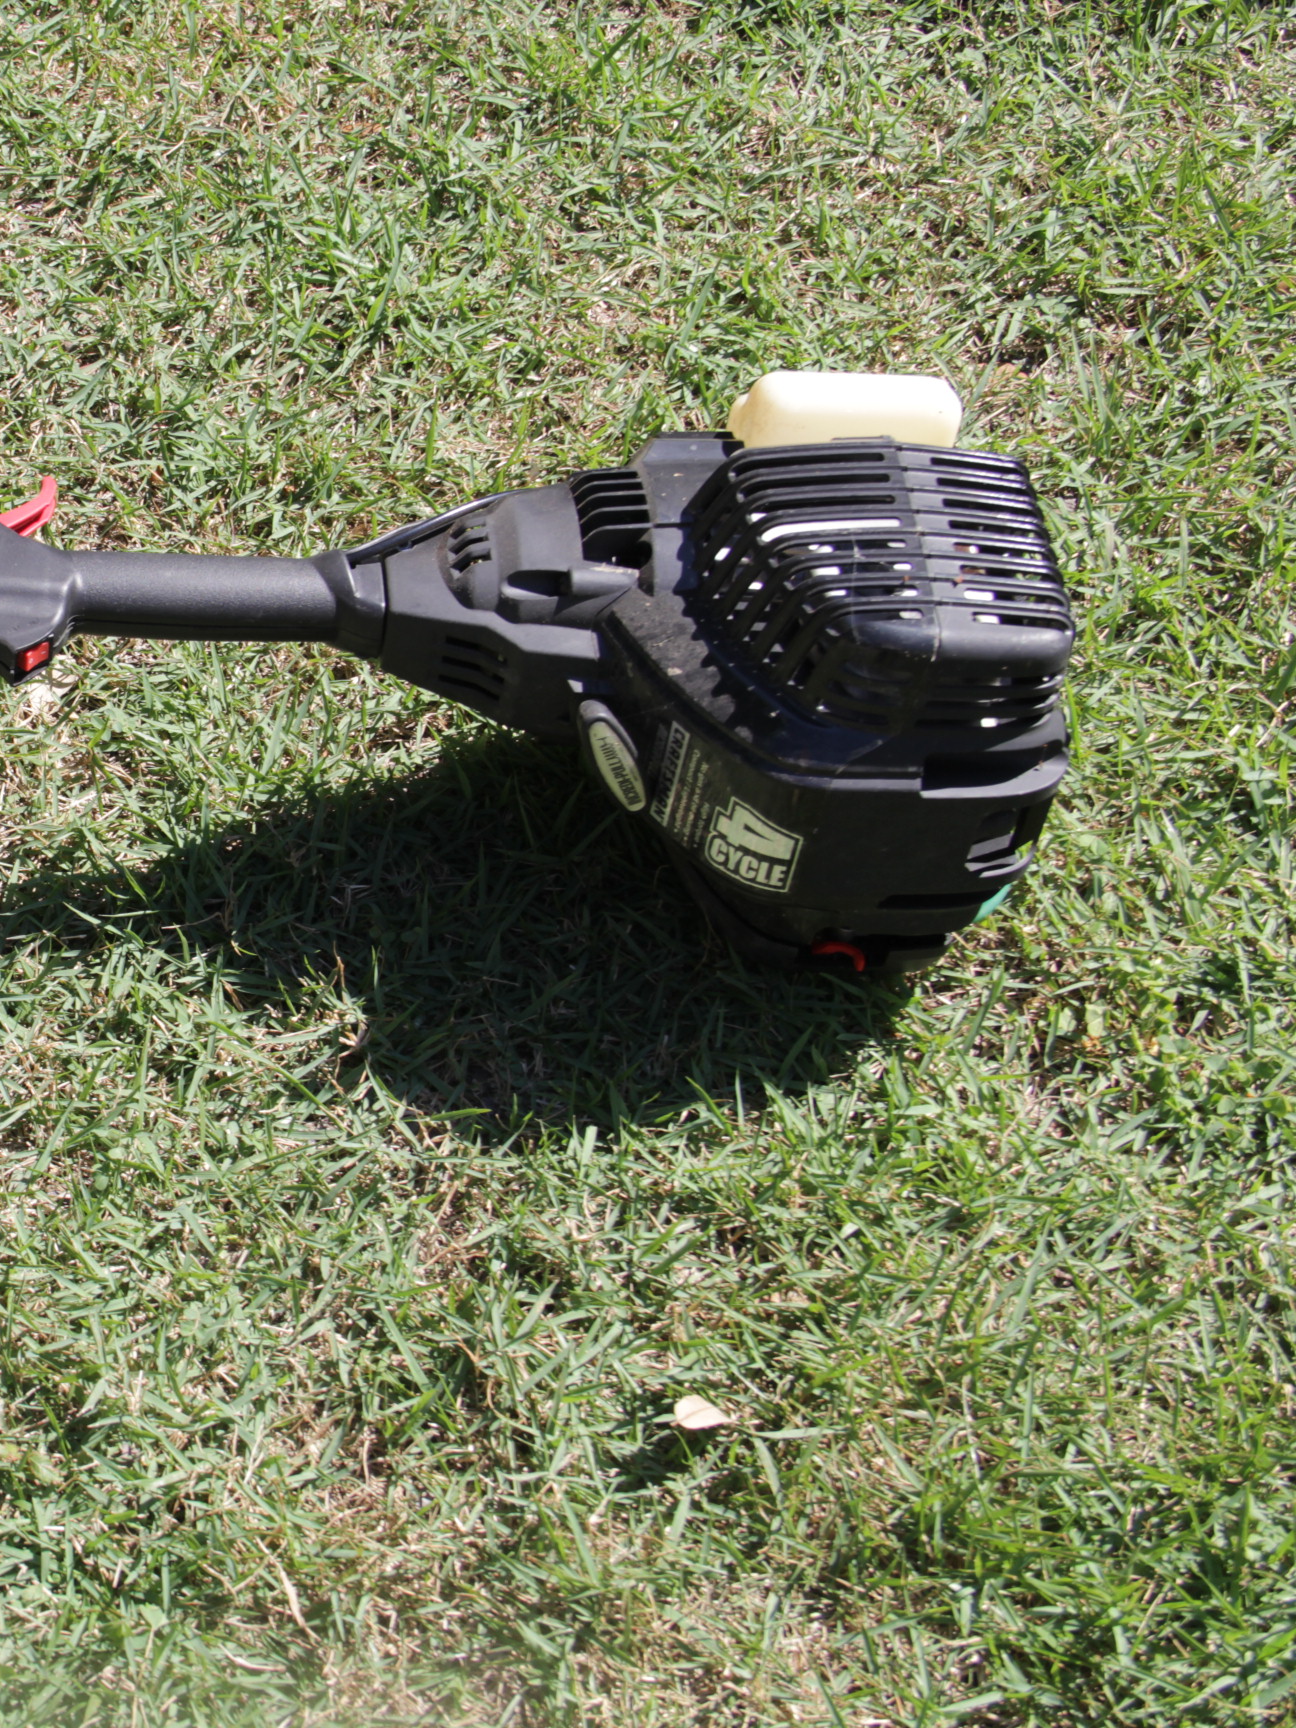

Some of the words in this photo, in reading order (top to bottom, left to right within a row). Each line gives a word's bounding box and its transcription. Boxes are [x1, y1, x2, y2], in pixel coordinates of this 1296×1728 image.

[653, 727, 685, 822] CRAFTSMAN
[716, 804, 795, 860] 4
[710, 837, 788, 887] CYCLE
